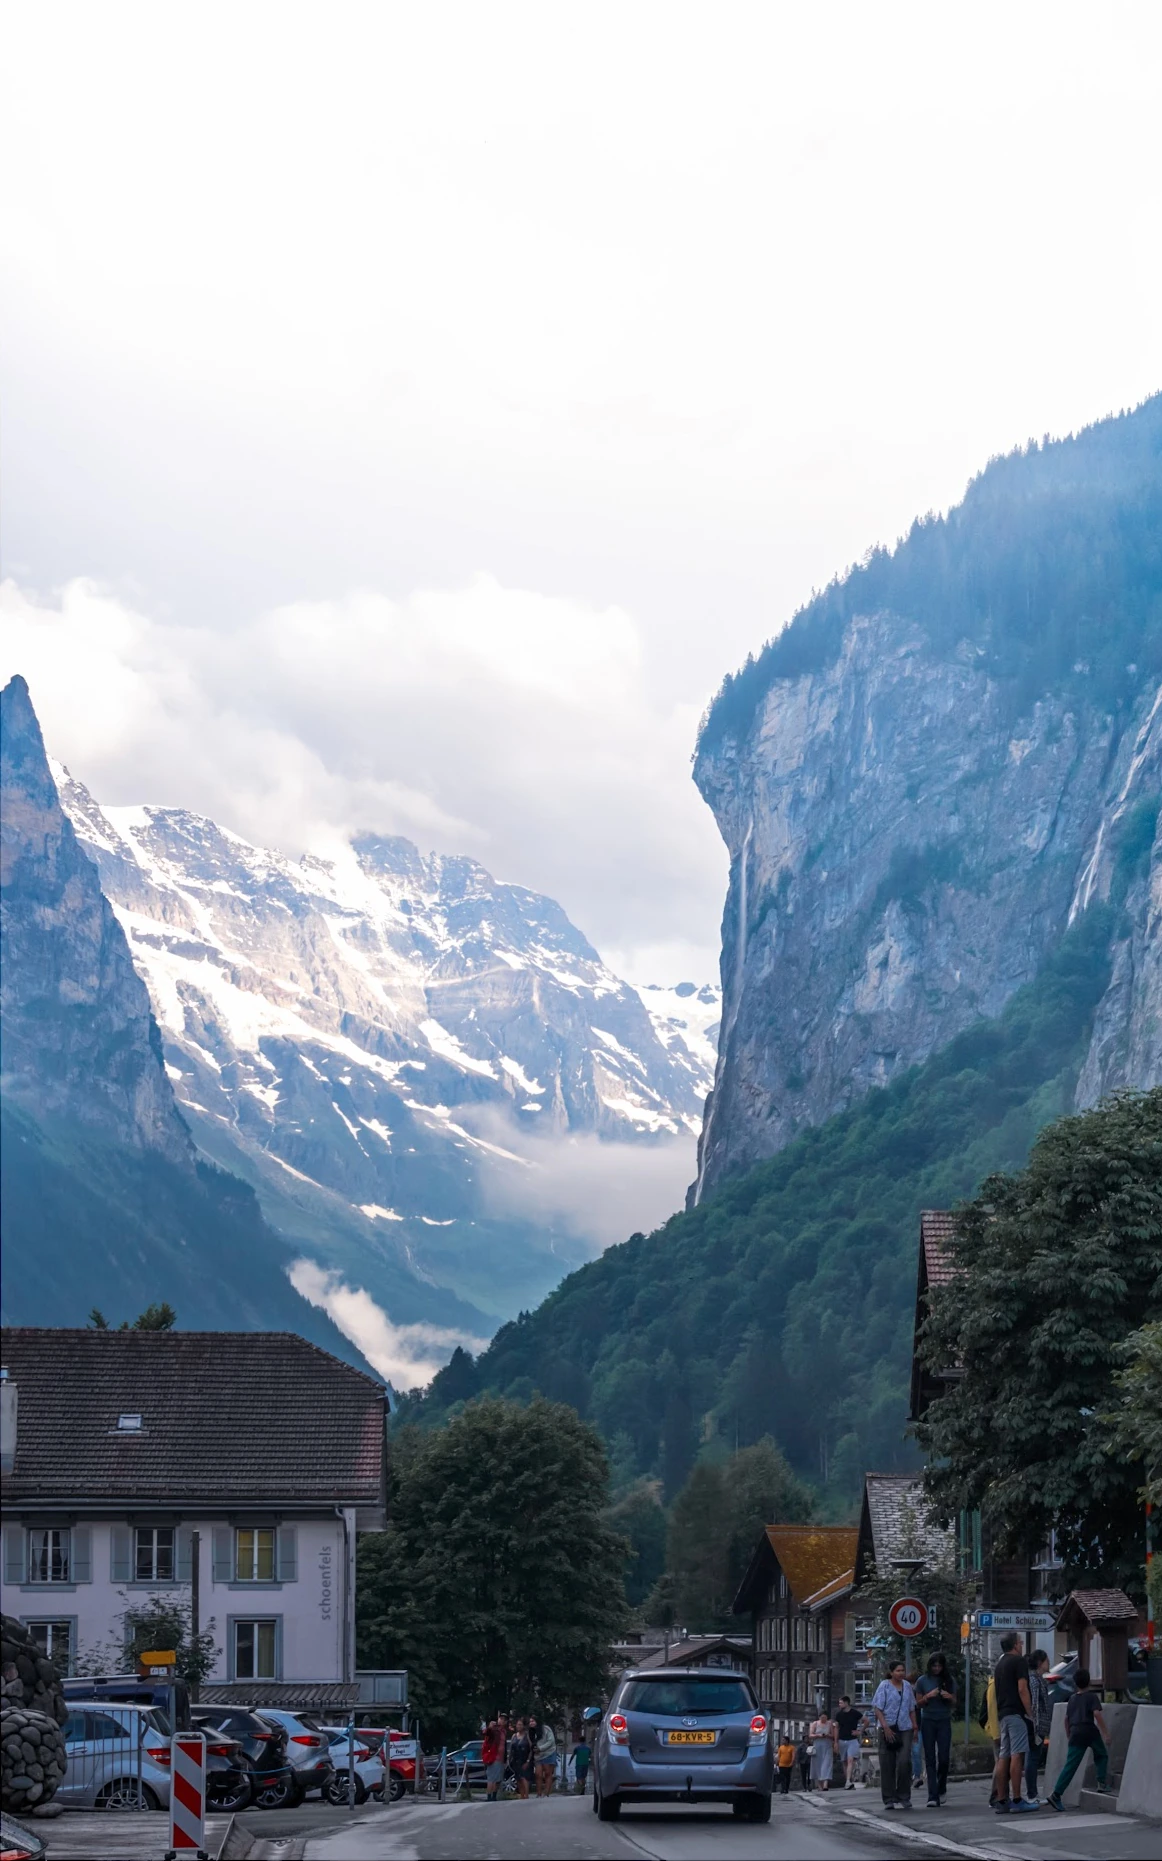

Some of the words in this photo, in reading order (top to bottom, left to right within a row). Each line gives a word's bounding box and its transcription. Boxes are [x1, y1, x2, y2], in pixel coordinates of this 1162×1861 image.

[318, 1546, 332, 1621] schoenfels
[901, 1610, 916, 1624] 40
[982, 1615, 990, 1625] P
[994, 1615, 1012, 1625] Hotel
[1015, 1615, 1047, 1626] Schützen
[670, 1732, 712, 1742] 68-KVR-5
